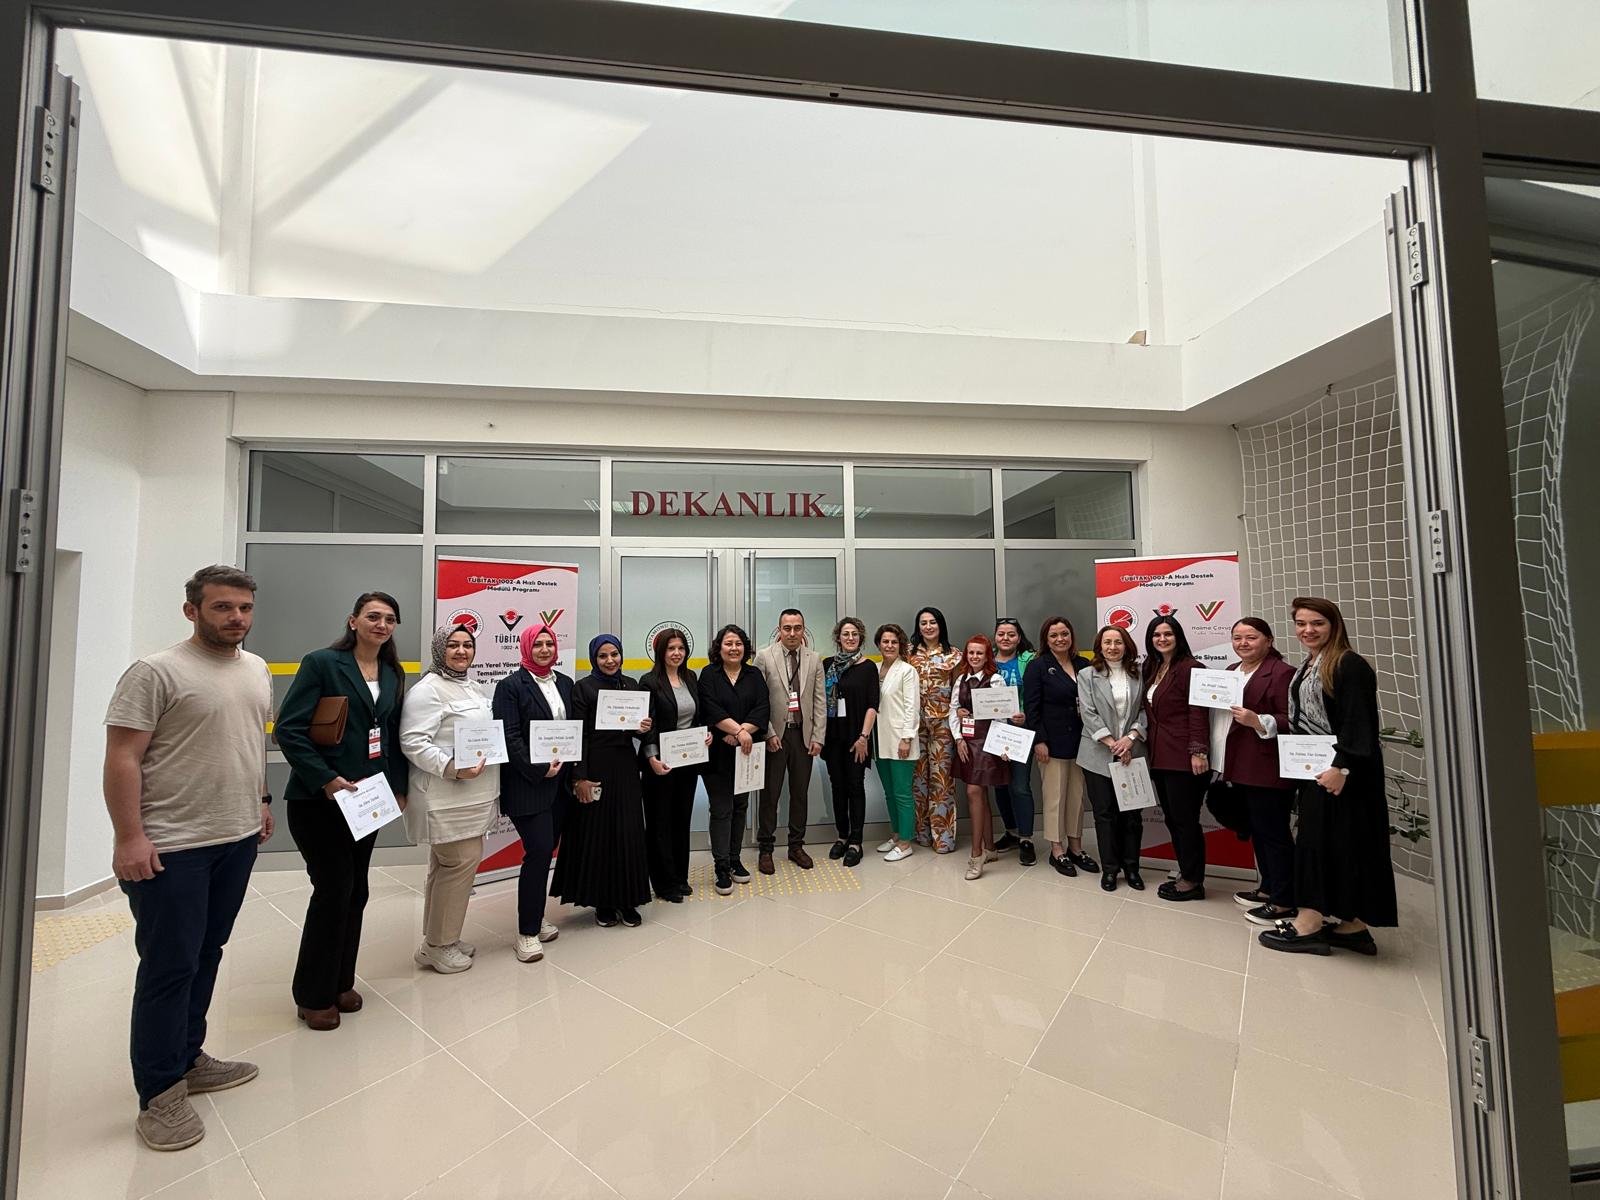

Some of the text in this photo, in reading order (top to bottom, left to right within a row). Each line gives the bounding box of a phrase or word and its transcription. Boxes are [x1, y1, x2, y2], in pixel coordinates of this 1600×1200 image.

[630, 491, 827, 518] DEKANLIK
[467, 576, 496, 584] TÜBİTAK
[494, 633, 520, 644] TÜBİTA
